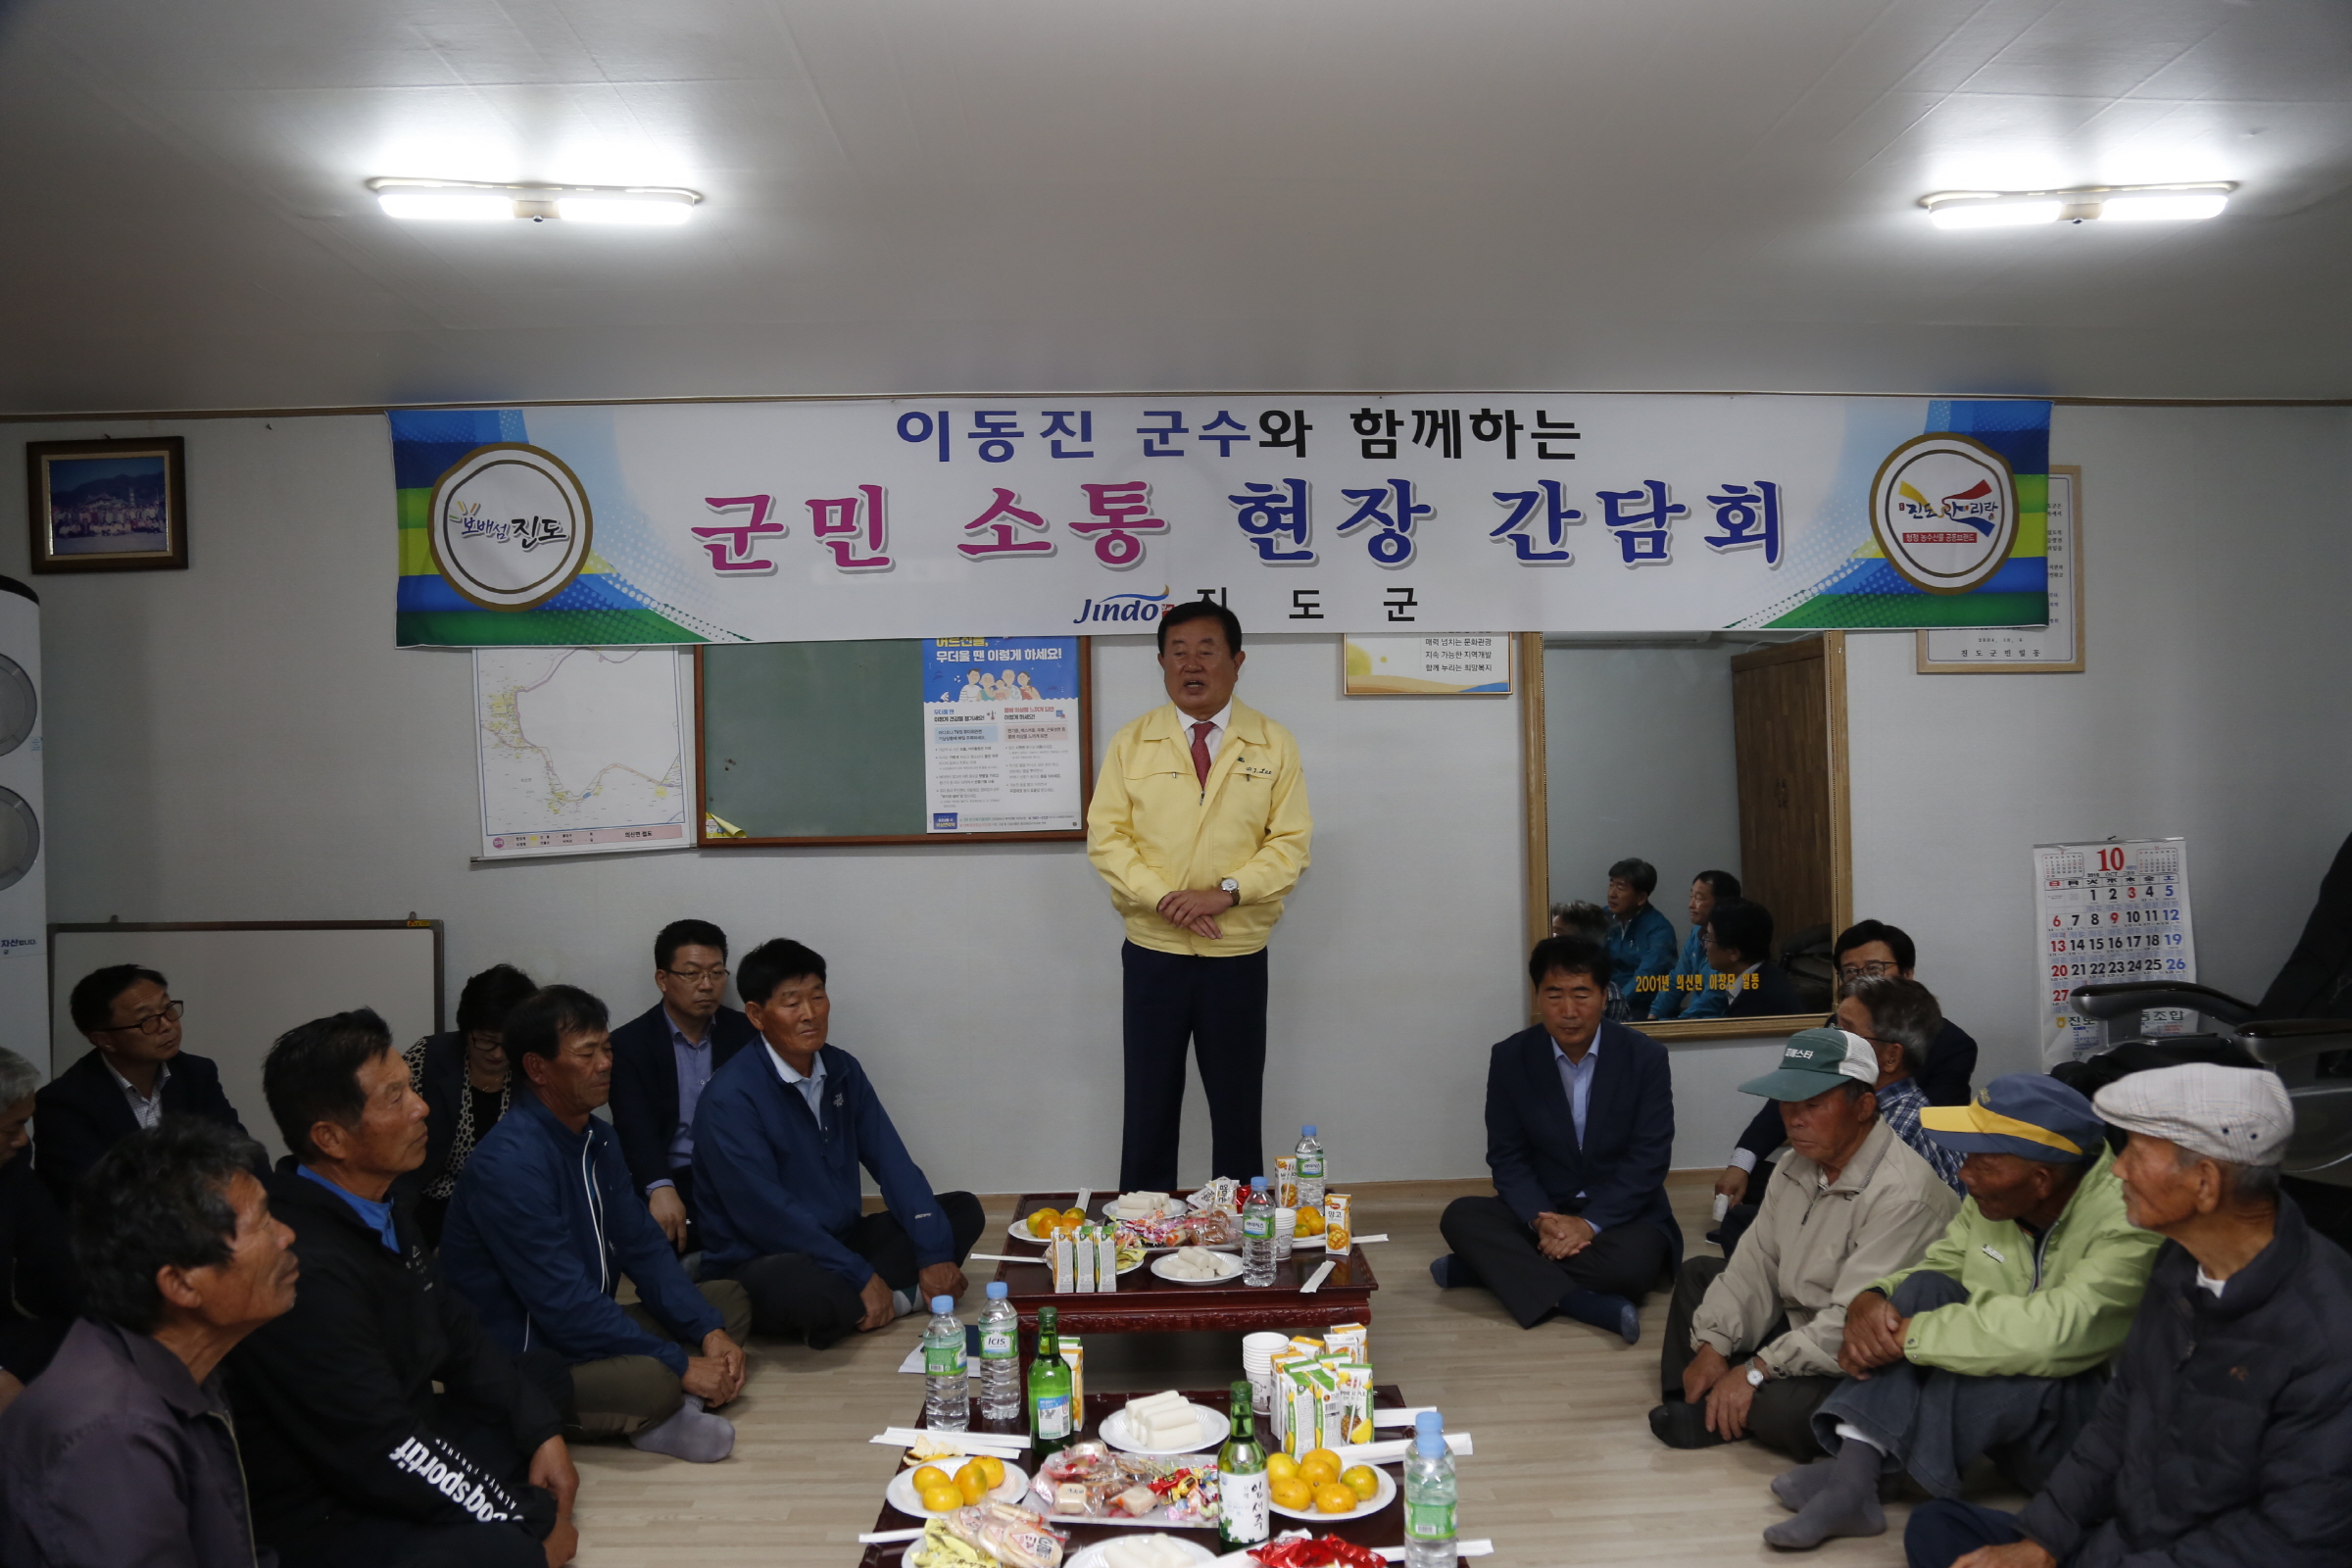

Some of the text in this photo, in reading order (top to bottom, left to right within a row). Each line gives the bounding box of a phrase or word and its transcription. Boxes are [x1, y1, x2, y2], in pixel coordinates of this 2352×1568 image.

[896, 407, 1581, 464] 이동진 군수와 함께하는
[1905, 502, 1938, 519] 진도
[462, 515, 567, 549] 보배섬 진도
[691, 478, 1780, 574] 군민 소통 현장 간담회
[1905, 533, 1976, 543] 청정 농수산물 공동브랜드
[1073, 599, 1159, 624] Jindo
[1425, 638, 1492, 647] 매력 넘치는 문화관광
[936, 648, 1062, 662] 무더울 땐 이렇게 하세요!
[1425, 651, 1440, 660] 지속
[1441, 651, 1462, 660] 가능한
[2096, 847, 2126, 871] 10
[2090, 889, 2096, 901] 1
[2108, 888, 2117, 901] 2
[2128, 886, 2136, 899] 3
[2145, 885, 2154, 897] 4
[2165, 885, 2174, 897] 5
[2052, 908, 2180, 927] 6 7 8 9 10 11 12
[2050, 933, 2182, 953] 13 14 15 16 17 18 19
[2050, 957, 2186, 977] 20 21 22 23 24 25 26
[1635, 972, 1760, 993] 2001년 의신면 이장단 일동
[2052, 989, 2070, 1002] 27
[435, 1438, 517, 1510] ALWAYS FURTHER
[1250, 1481, 1263, 1532] 잎새주
